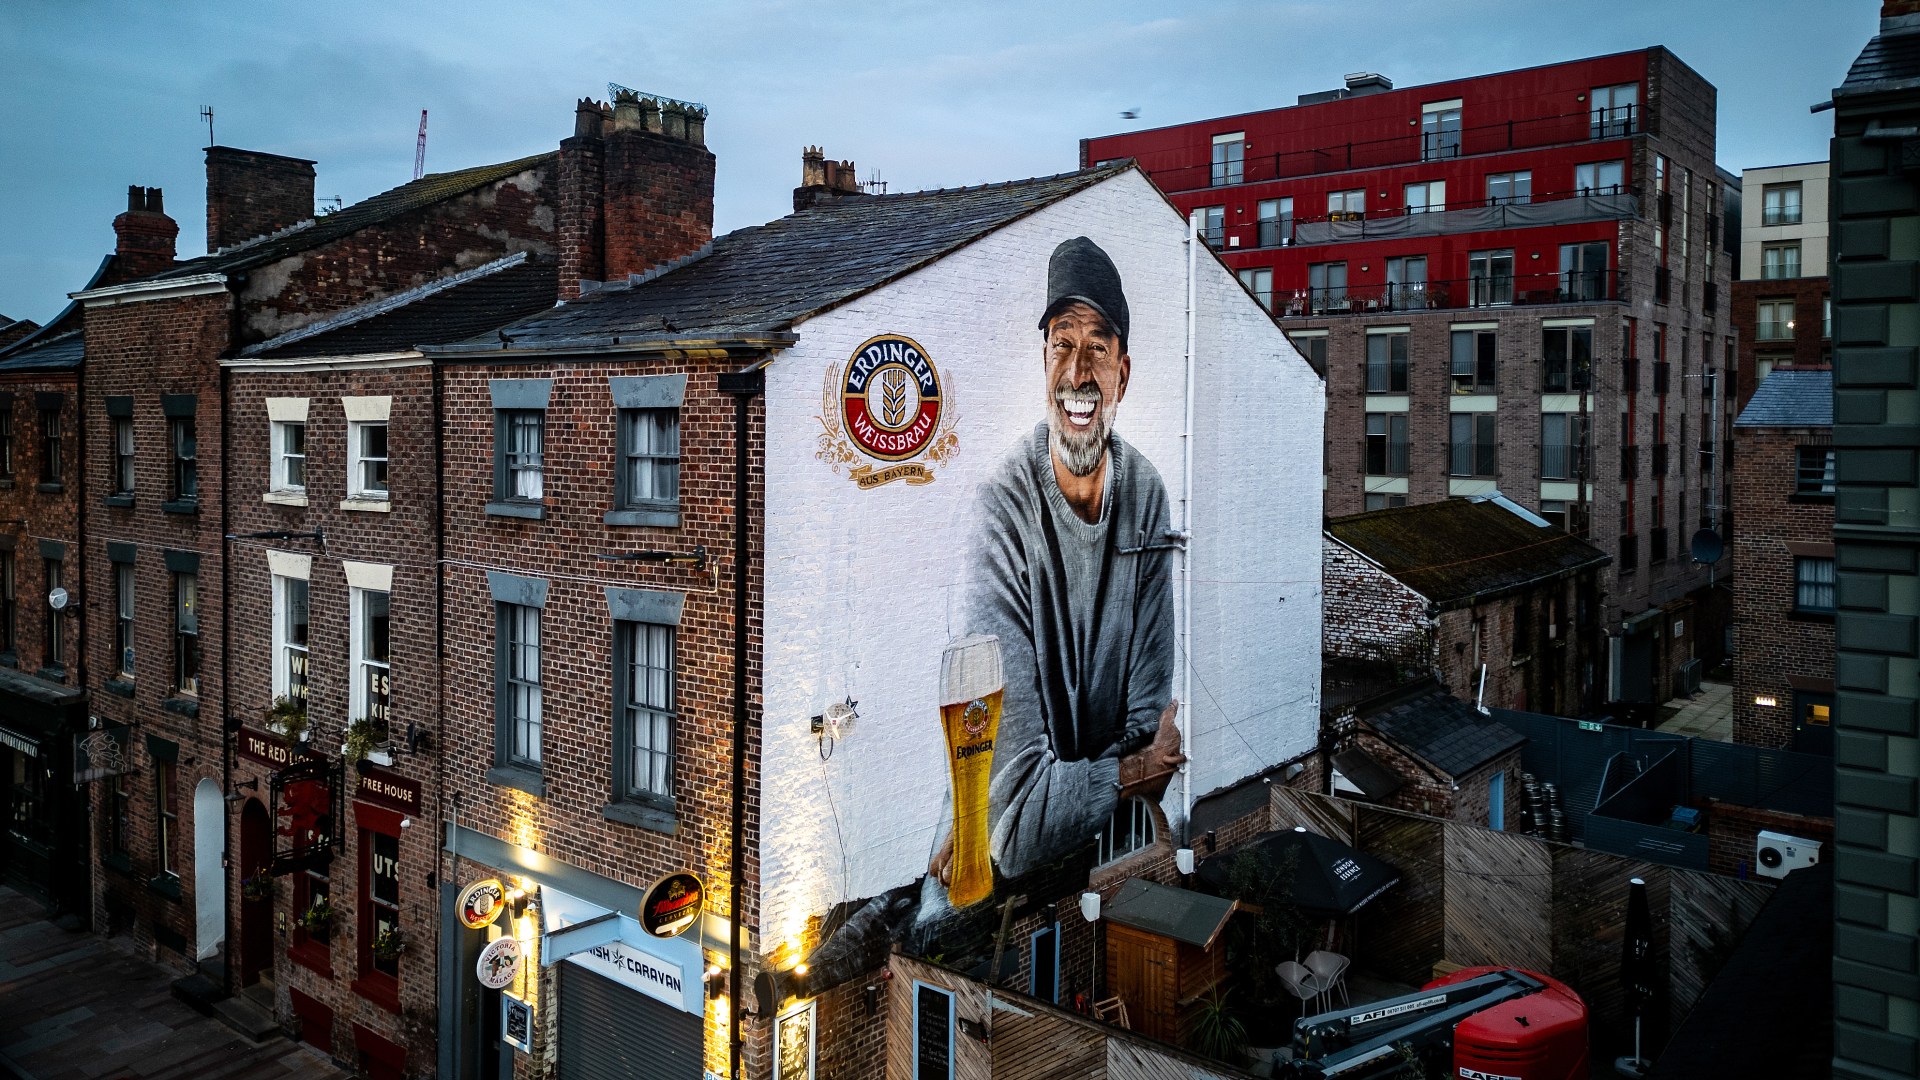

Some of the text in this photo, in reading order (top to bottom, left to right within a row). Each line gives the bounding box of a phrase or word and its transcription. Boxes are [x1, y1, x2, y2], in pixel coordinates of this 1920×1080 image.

[848, 343, 933, 391] ERDINGER
[859, 466, 925, 486] AUS BAYERN
[248, 737, 266, 756] THE
[268, 744, 287, 764] RED
[956, 740, 993, 759] ERDINGER
[362, 777, 413, 802] FREE HOUSE
[1334, 859, 1354, 875] LONDON
[467, 886, 500, 907] ERDINGER
[653, 890, 699, 917] Alhambra
[485, 942, 516, 963] VICTORIA
[627, 957, 682, 993] CARAVAN
[1363, 1010, 1385, 1020] AFI
